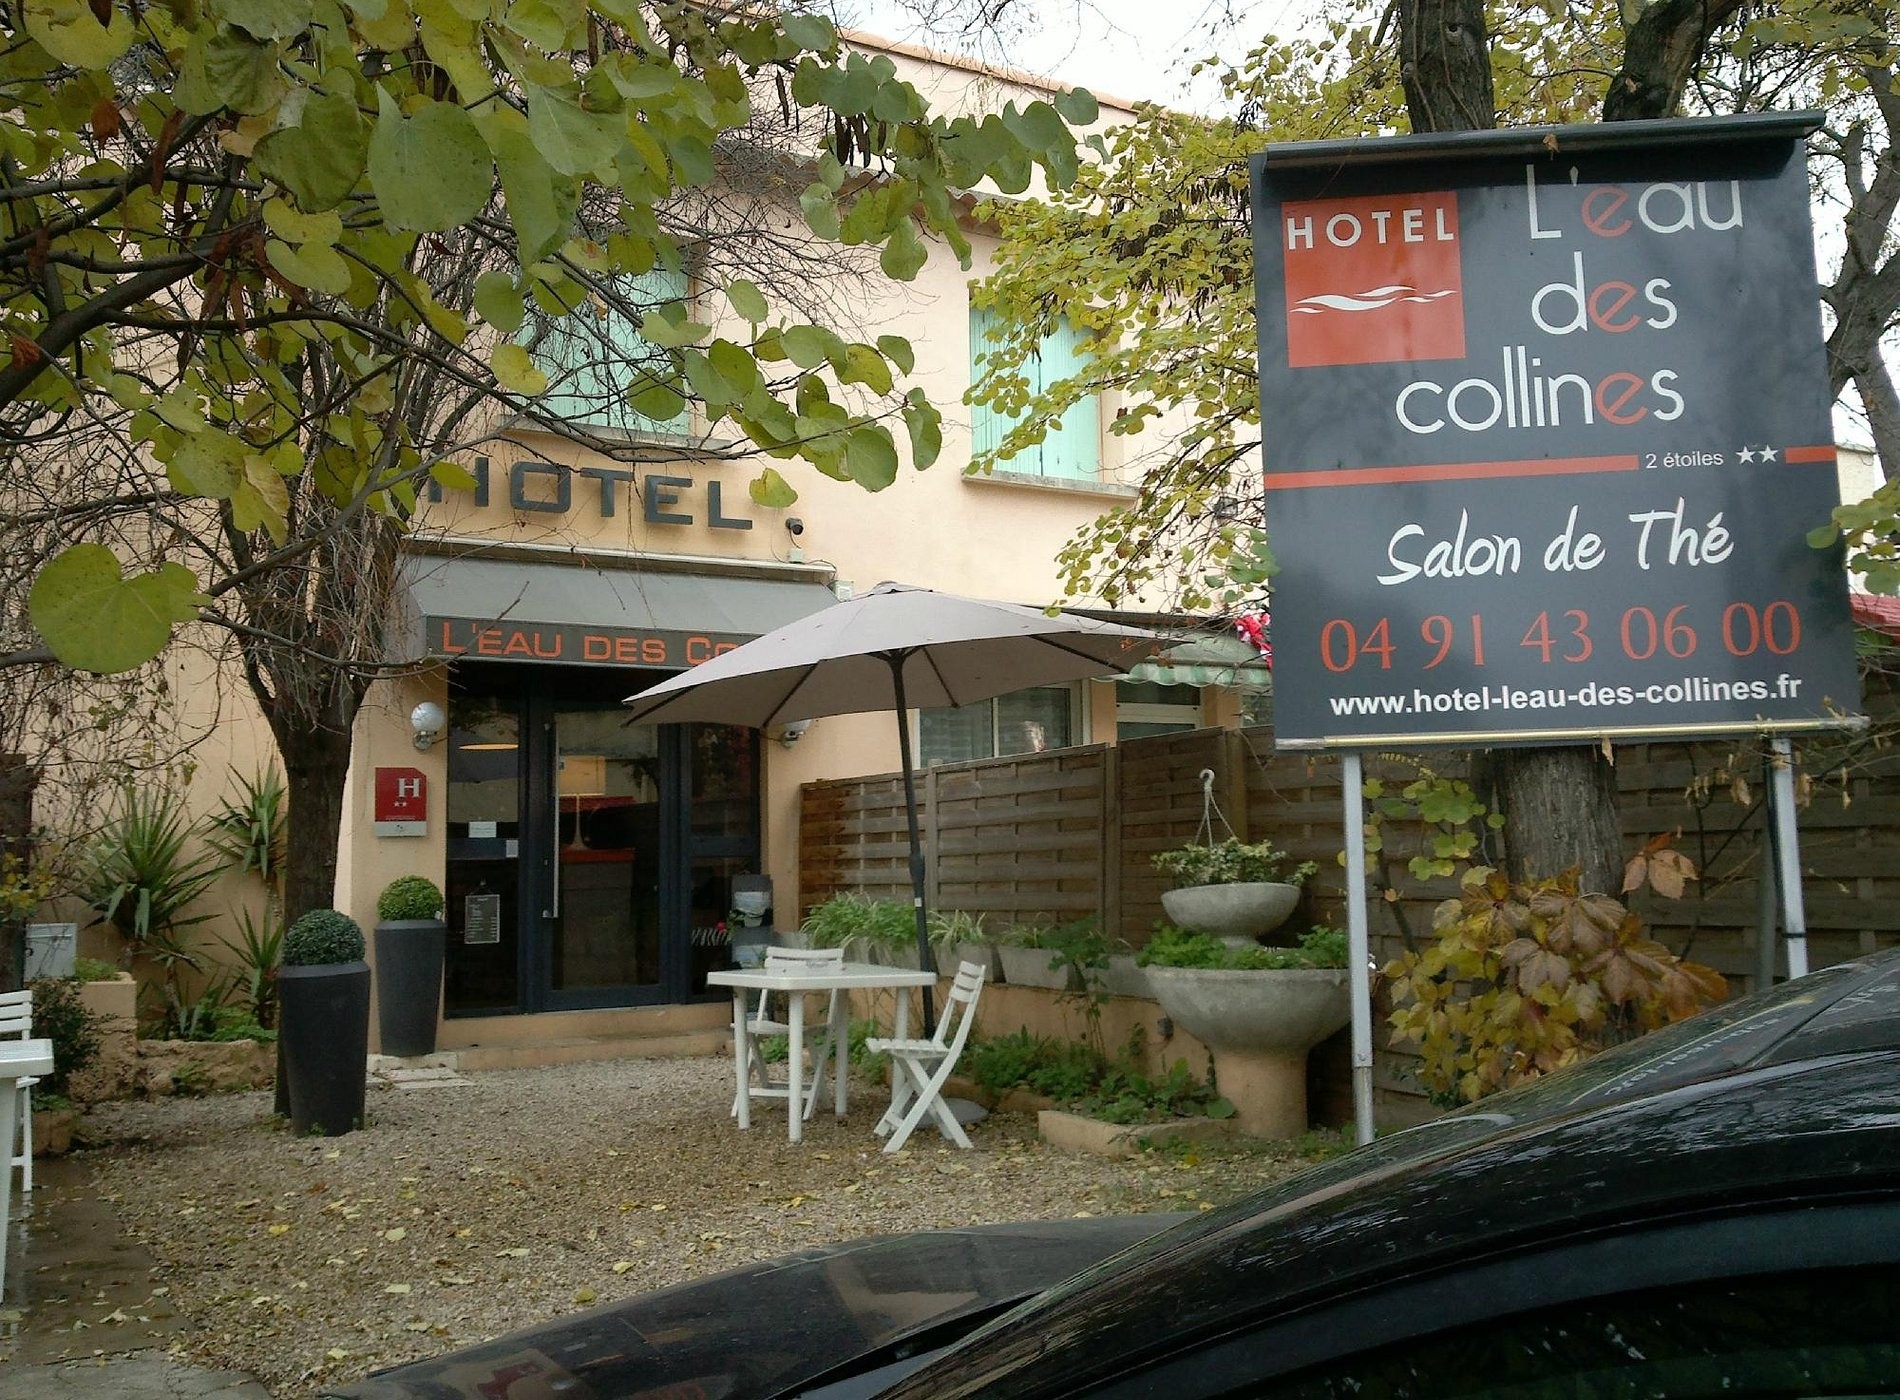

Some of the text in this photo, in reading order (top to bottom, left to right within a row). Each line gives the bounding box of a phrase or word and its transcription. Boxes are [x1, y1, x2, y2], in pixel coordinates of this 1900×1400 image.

[1286, 206, 1455, 251] HOTEL
[1526, 164, 1744, 240] L'eau
[1531, 250, 1679, 336] des
[1396, 345, 1685, 434] collines
[1645, 450, 1725, 470] 2 étoiles
[1376, 497, 1734, 585] Salon de Thé
[442, 621, 562, 658] L'EAU
[583, 635, 667, 664] DES
[1320, 601, 1801, 673] 04 91 43 06 00
[1330, 673, 1802, 717] www.hotel-leau-des-collines.fr
[398, 778, 420, 798] H
